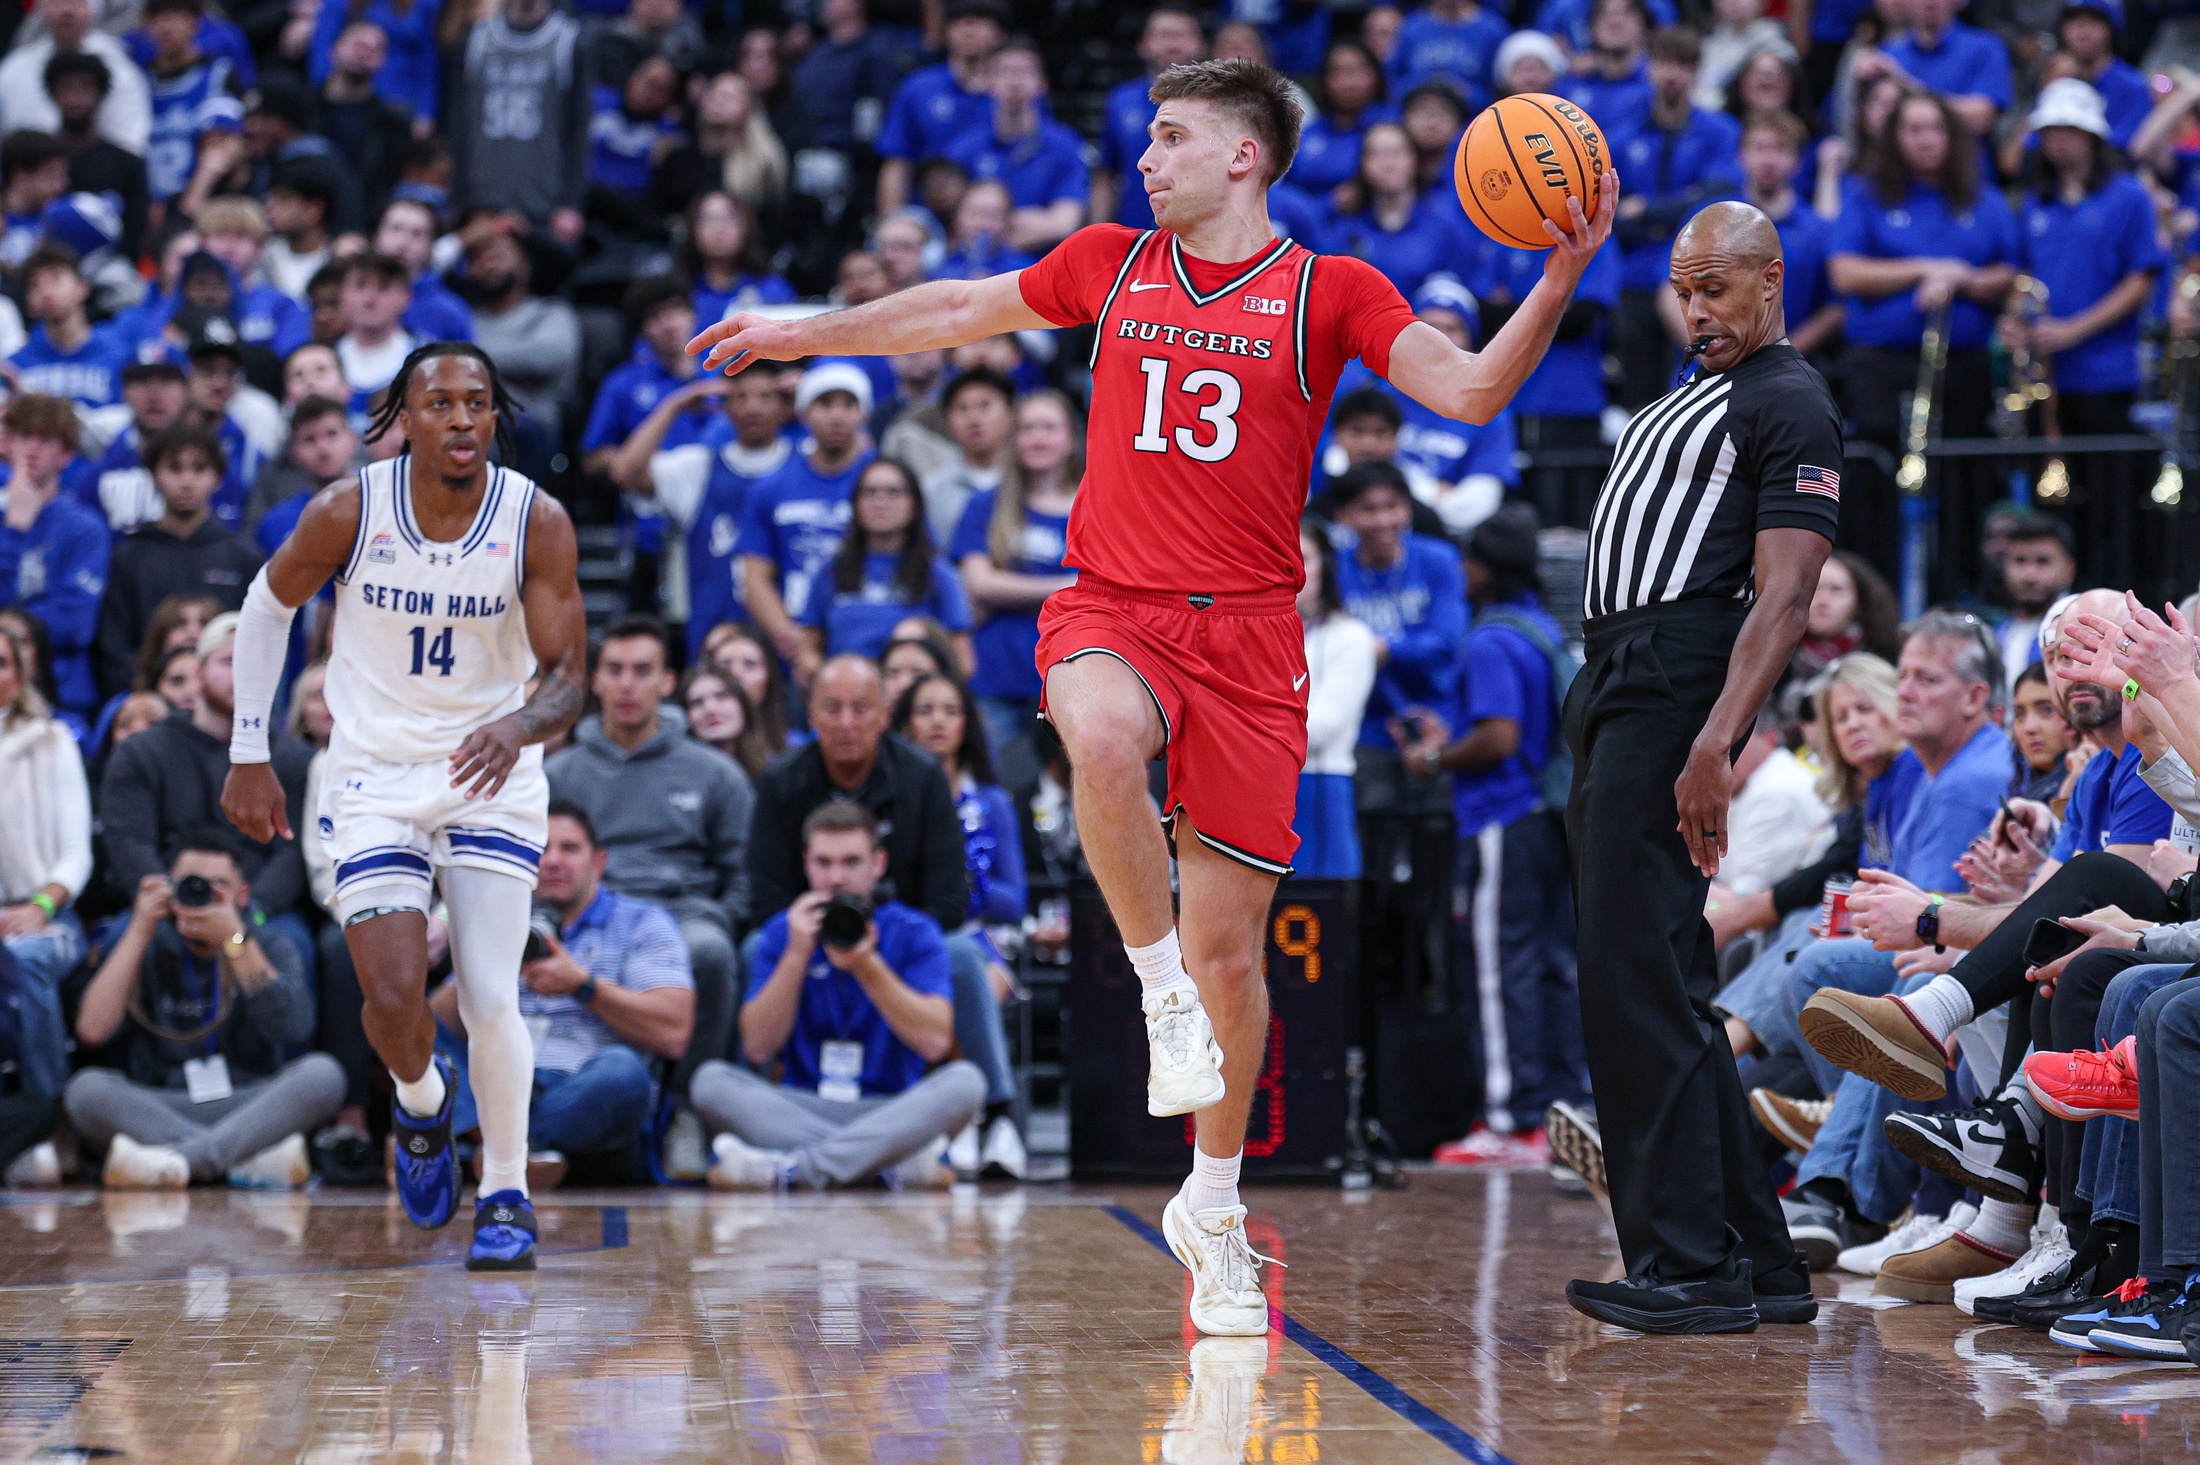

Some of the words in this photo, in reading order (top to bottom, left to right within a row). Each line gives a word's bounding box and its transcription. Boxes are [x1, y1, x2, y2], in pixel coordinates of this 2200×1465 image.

[1523, 132, 1568, 188] EVO
[1117, 318, 1272, 359] RUTGERS
[1133, 356, 1243, 463] 13
[363, 583, 435, 616] SETON
[447, 594, 506, 618] HALL
[408, 626, 456, 677] 14
